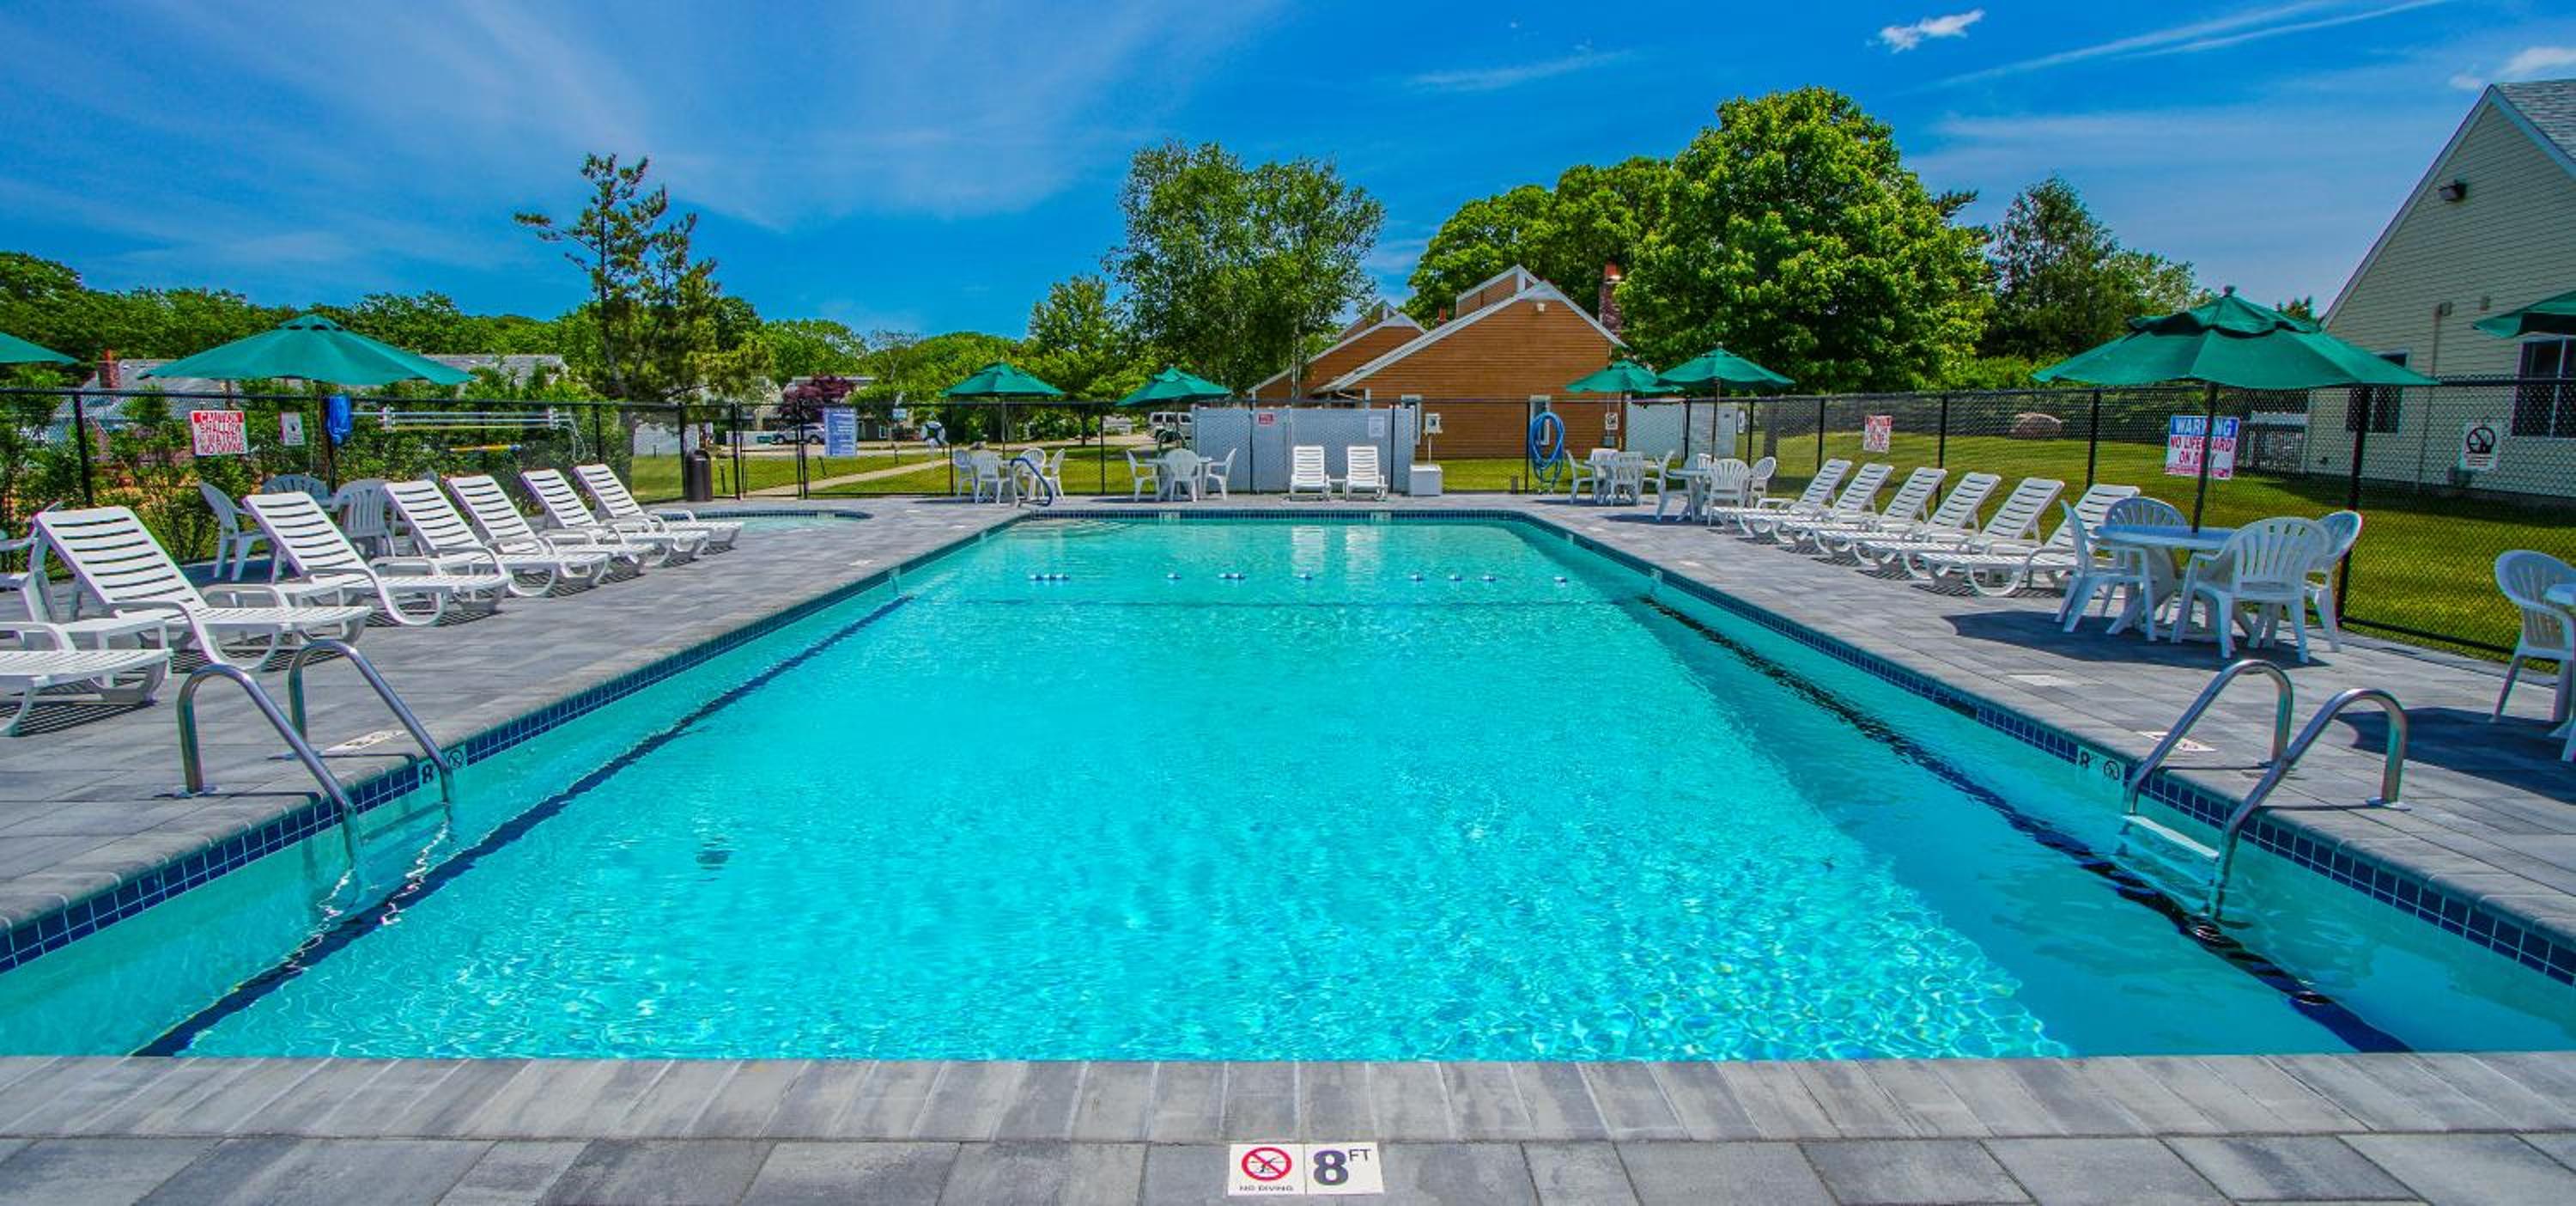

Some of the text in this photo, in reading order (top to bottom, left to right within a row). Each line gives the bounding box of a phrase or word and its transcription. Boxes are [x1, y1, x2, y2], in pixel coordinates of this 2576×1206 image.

[199, 423, 241, 435] SHALLOW
[2175, 417, 2233, 436] WARNG
[2170, 436, 2233, 452] NO LIFEARD
[2080, 752, 2091, 769] 8
[422, 764, 434, 784] 8
[1313, 1148, 1371, 1186] 8 FT
